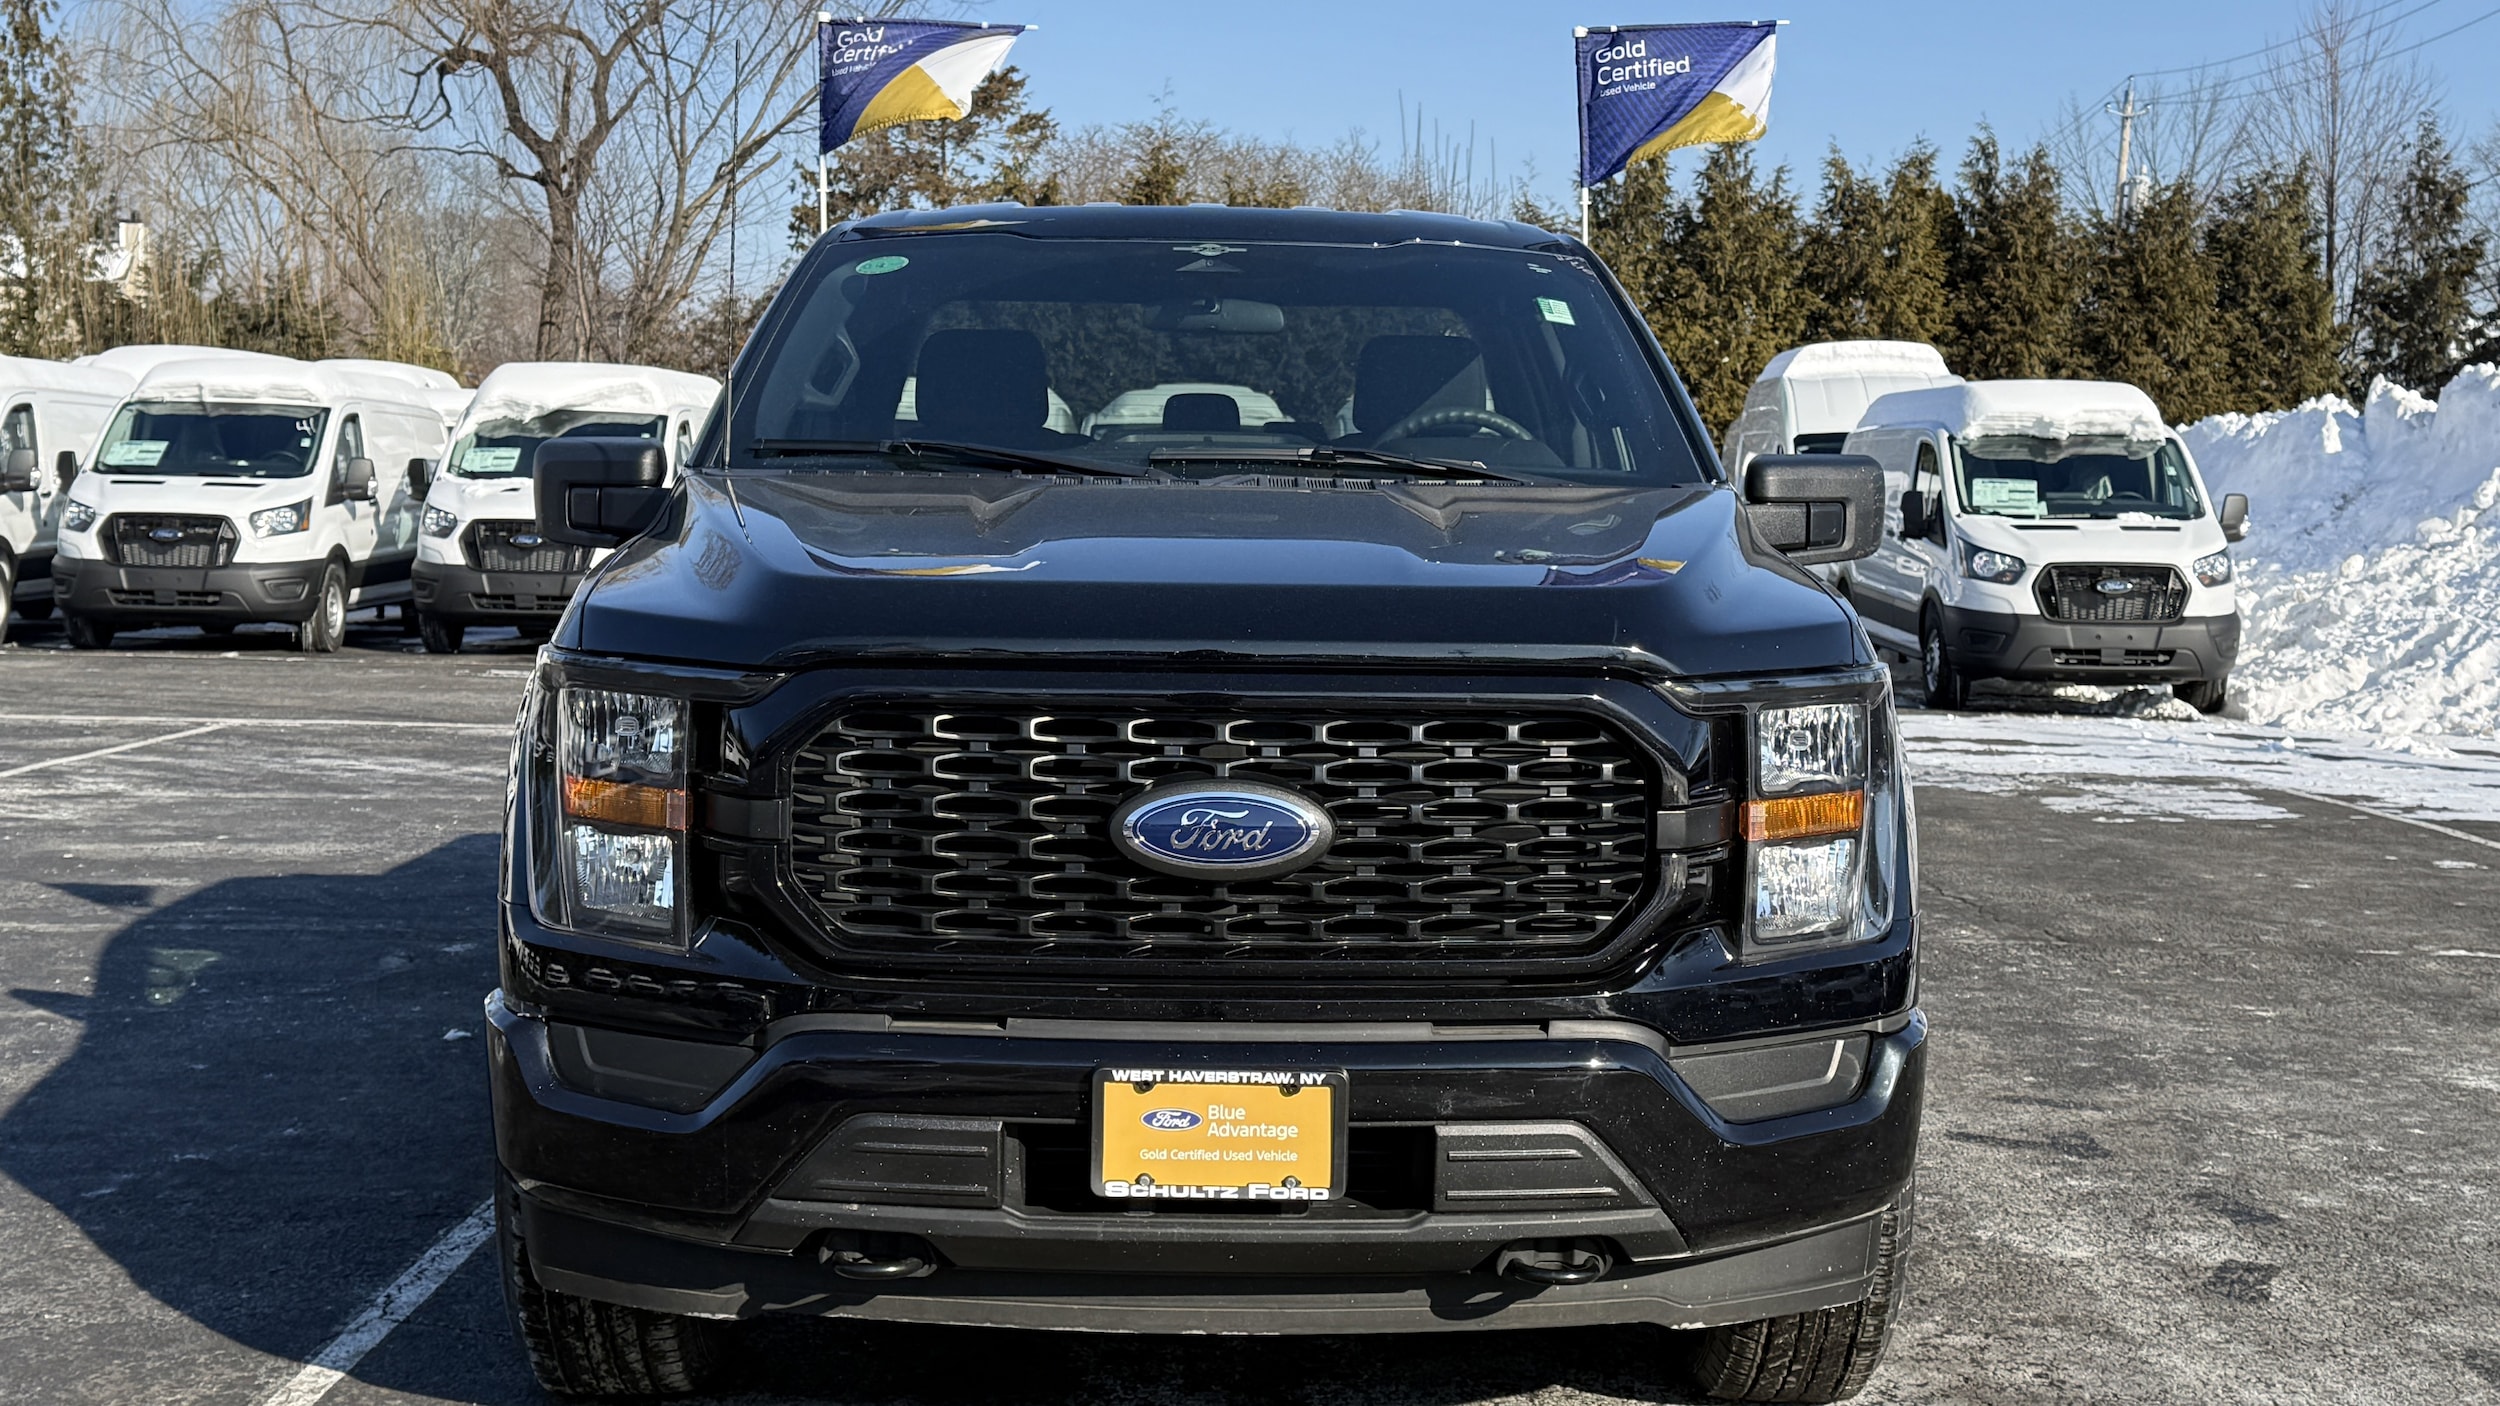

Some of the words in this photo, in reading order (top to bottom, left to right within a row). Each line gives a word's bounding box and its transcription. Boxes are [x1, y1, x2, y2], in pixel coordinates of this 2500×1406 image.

[1595, 39, 1646, 63] Gold
[1597, 56, 1691, 85] Certified
[1623, 81, 1656, 92] Vehicle
[1170, 808, 1274, 851] Ford
[1111, 1070, 1165, 1082] WEST
[1299, 1073, 1327, 1085] NY
[1152, 1111, 1191, 1128] Ford
[1207, 1104, 1246, 1120] Blue
[1207, 1122, 1298, 1140] Advantage
[1139, 1148, 1167, 1160] Gold
[1170, 1148, 1219, 1161] Certified
[1223, 1150, 1253, 1161] Used
[1256, 1150, 1298, 1162] Vehicle
